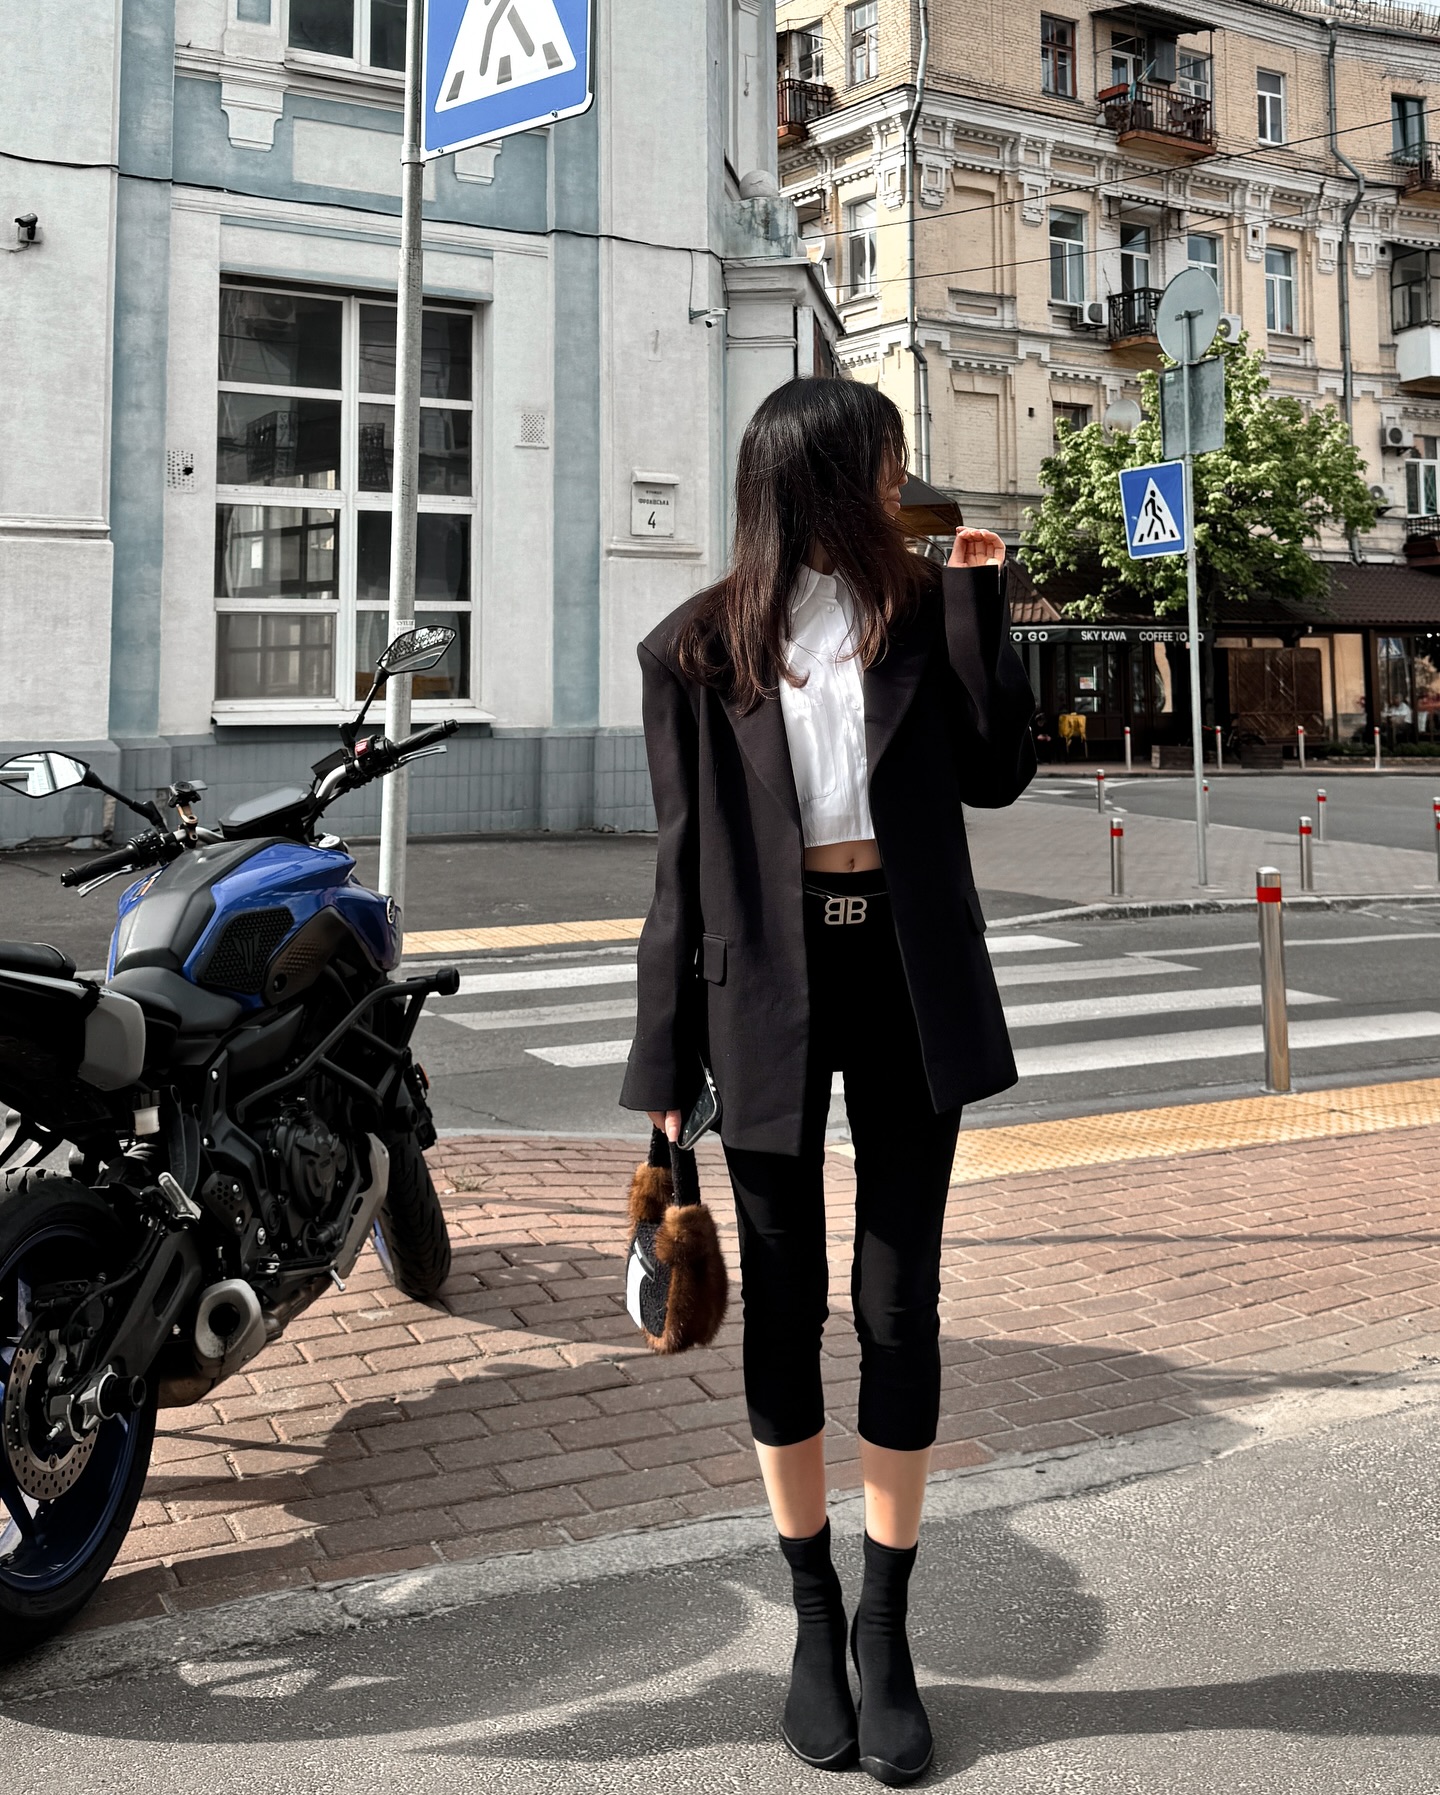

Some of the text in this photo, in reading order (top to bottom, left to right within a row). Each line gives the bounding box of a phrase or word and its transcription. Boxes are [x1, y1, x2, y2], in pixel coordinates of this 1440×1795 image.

[648, 511, 656, 529] 4
[1010, 631, 1048, 641] O GO
[1081, 631, 1100, 641] SKY
[1101, 631, 1126, 641] KAVA
[1139, 631, 1173, 641] COFFEE
[1175, 632, 1188, 641] TO
